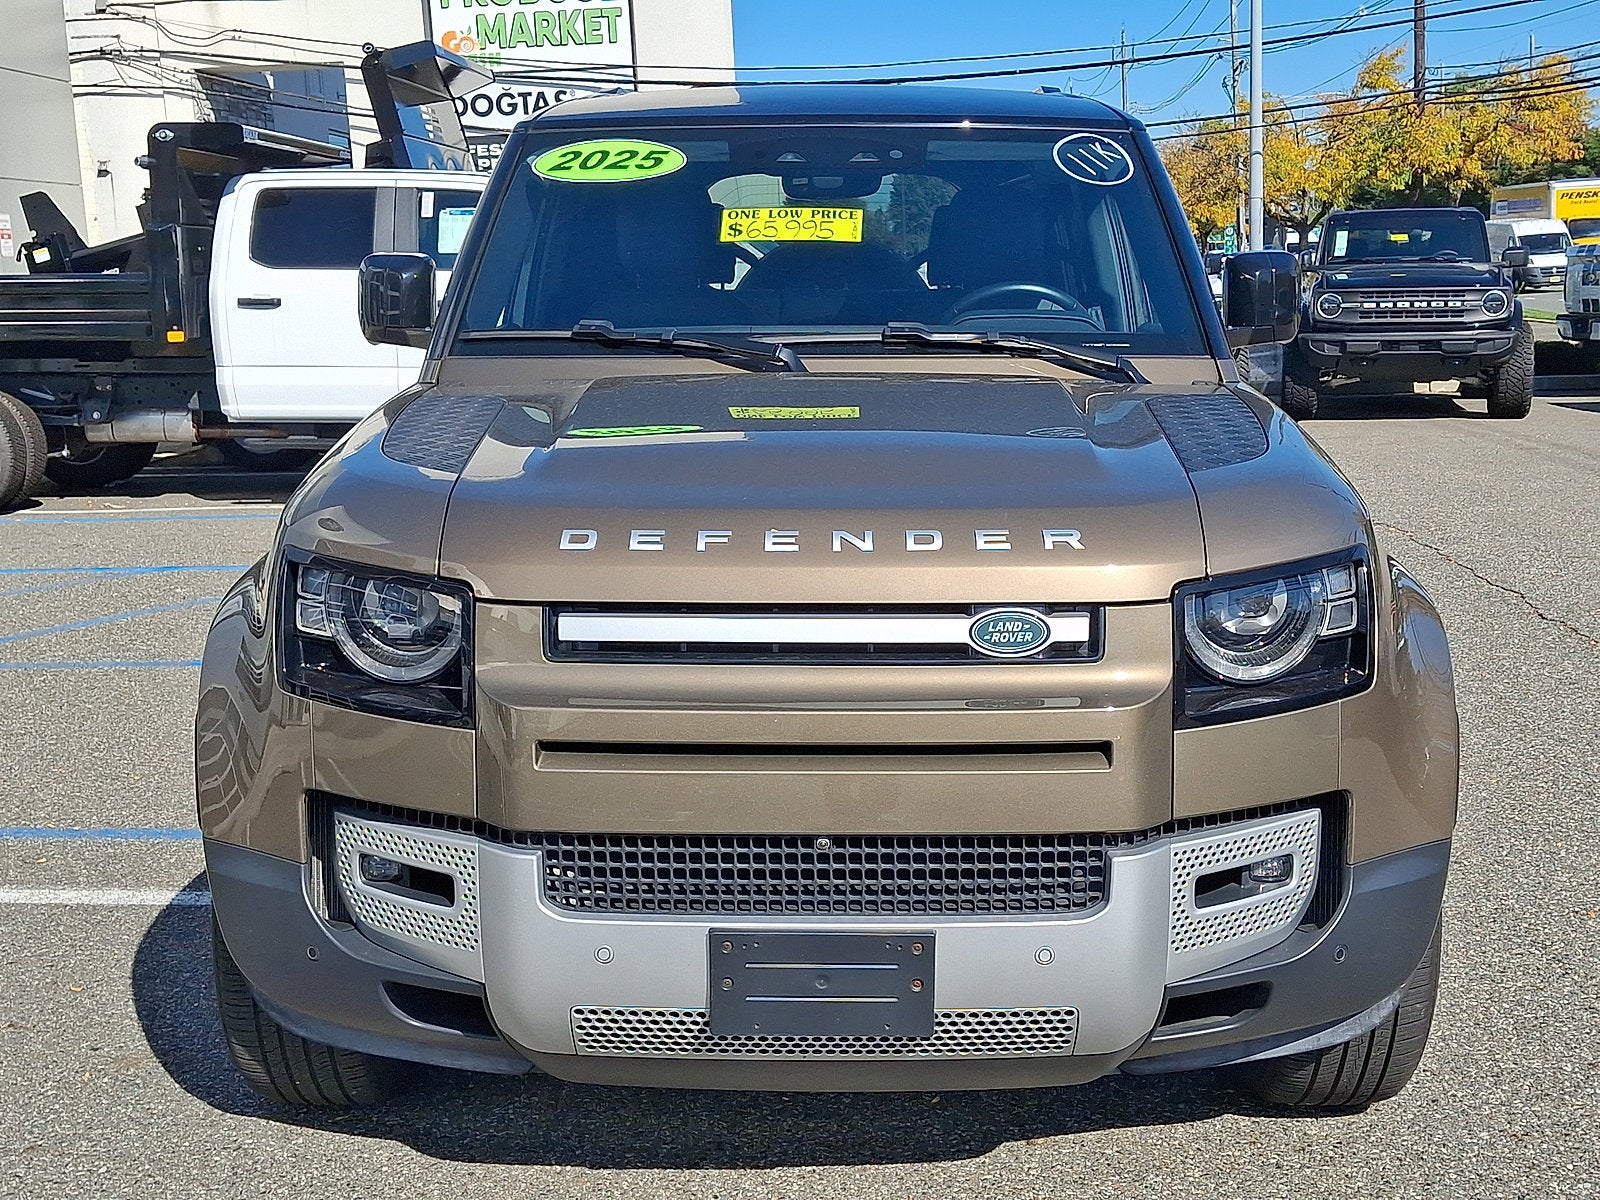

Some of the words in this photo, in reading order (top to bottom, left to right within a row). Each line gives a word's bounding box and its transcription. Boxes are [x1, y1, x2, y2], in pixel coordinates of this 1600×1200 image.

[476, 7, 622, 49] MARKET
[468, 144, 506, 157] FES
[1066, 142, 1122, 175] 11K
[547, 150, 670, 171] 2025
[727, 210, 760, 219] ONE
[769, 210, 803, 219] LOW
[811, 210, 858, 219] PRICE
[559, 528, 1085, 552] DEFENDER
[988, 621, 1022, 632] LAND
[991, 632, 1033, 643] ROVER
